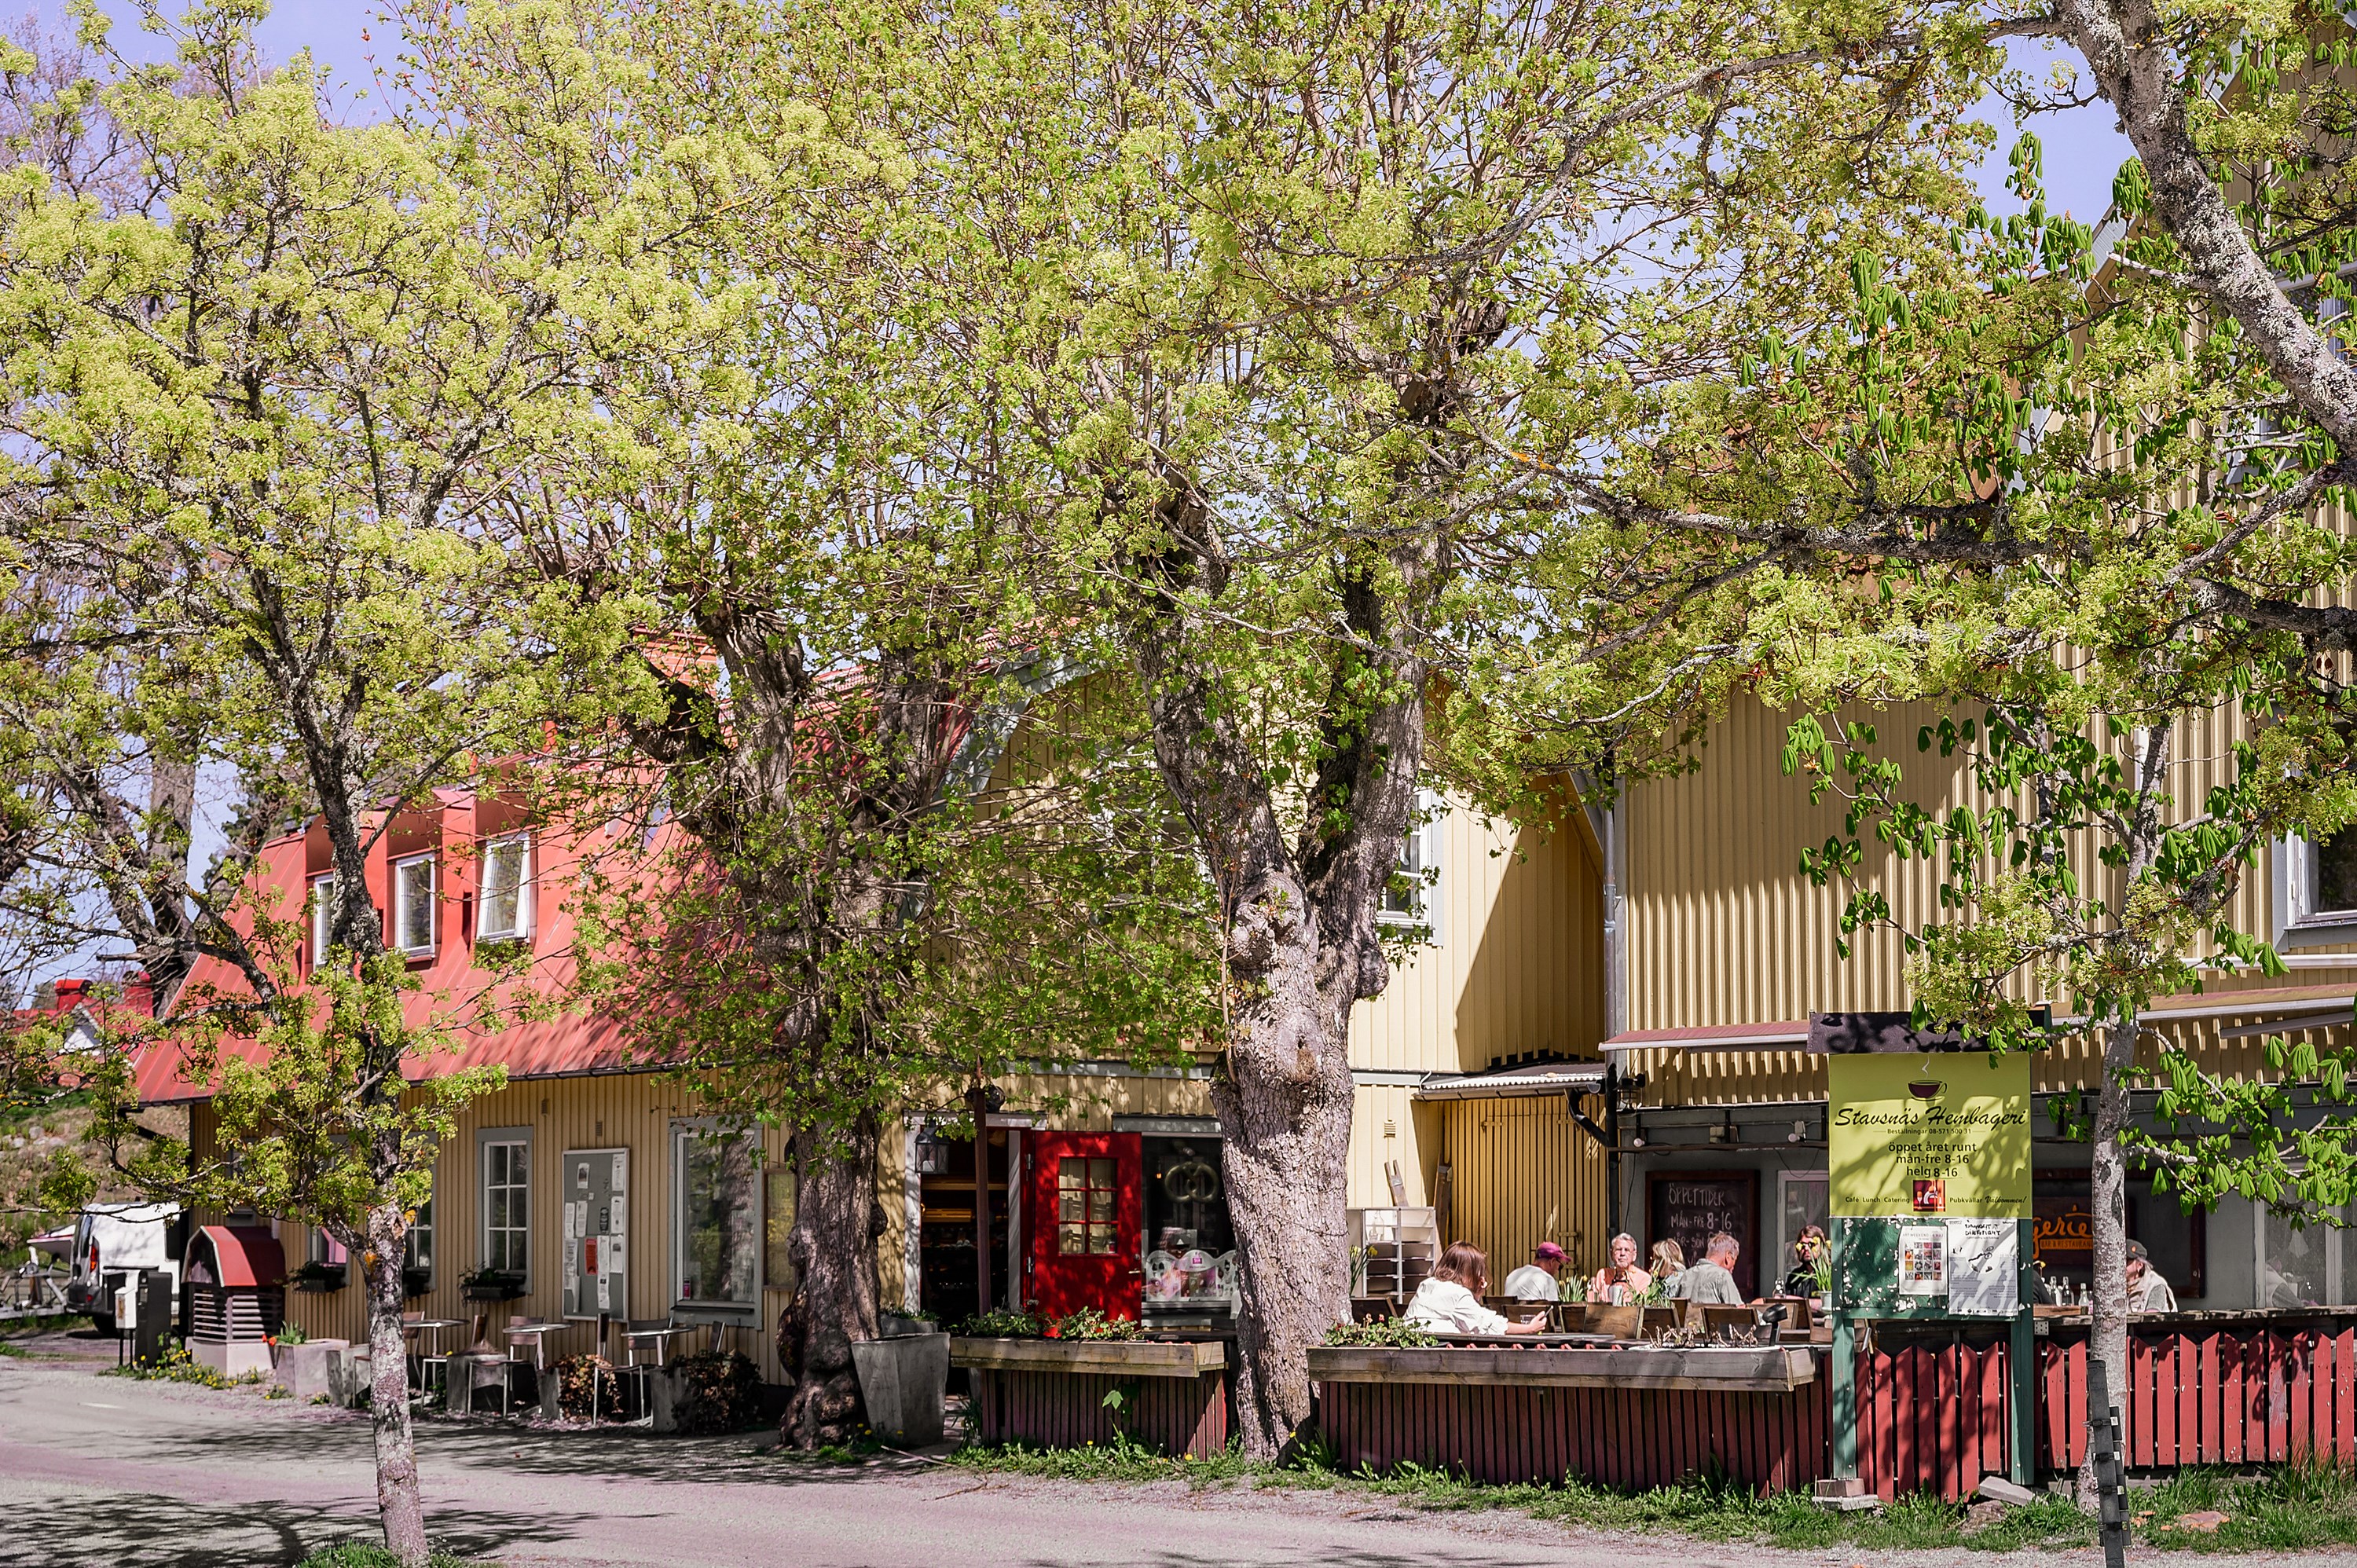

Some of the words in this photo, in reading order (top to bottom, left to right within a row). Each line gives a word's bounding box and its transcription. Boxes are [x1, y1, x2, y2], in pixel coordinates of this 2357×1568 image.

[1835, 1108, 1919, 1126] Stavsnäs
[1924, 1106, 2025, 1131] Hembageri
[1889, 1141, 1923, 1153] öppet
[1926, 1141, 1948, 1152] året
[1952, 1143, 1977, 1152] runt
[1896, 1154, 1941, 1164] mån-fre
[1945, 1155, 1969, 1164] 8-16
[1907, 1166, 1930, 1178] helg
[1984, 1195, 2027, 1204] Välkommen!
[2058, 1240, 2093, 1248] RESTAURAN
